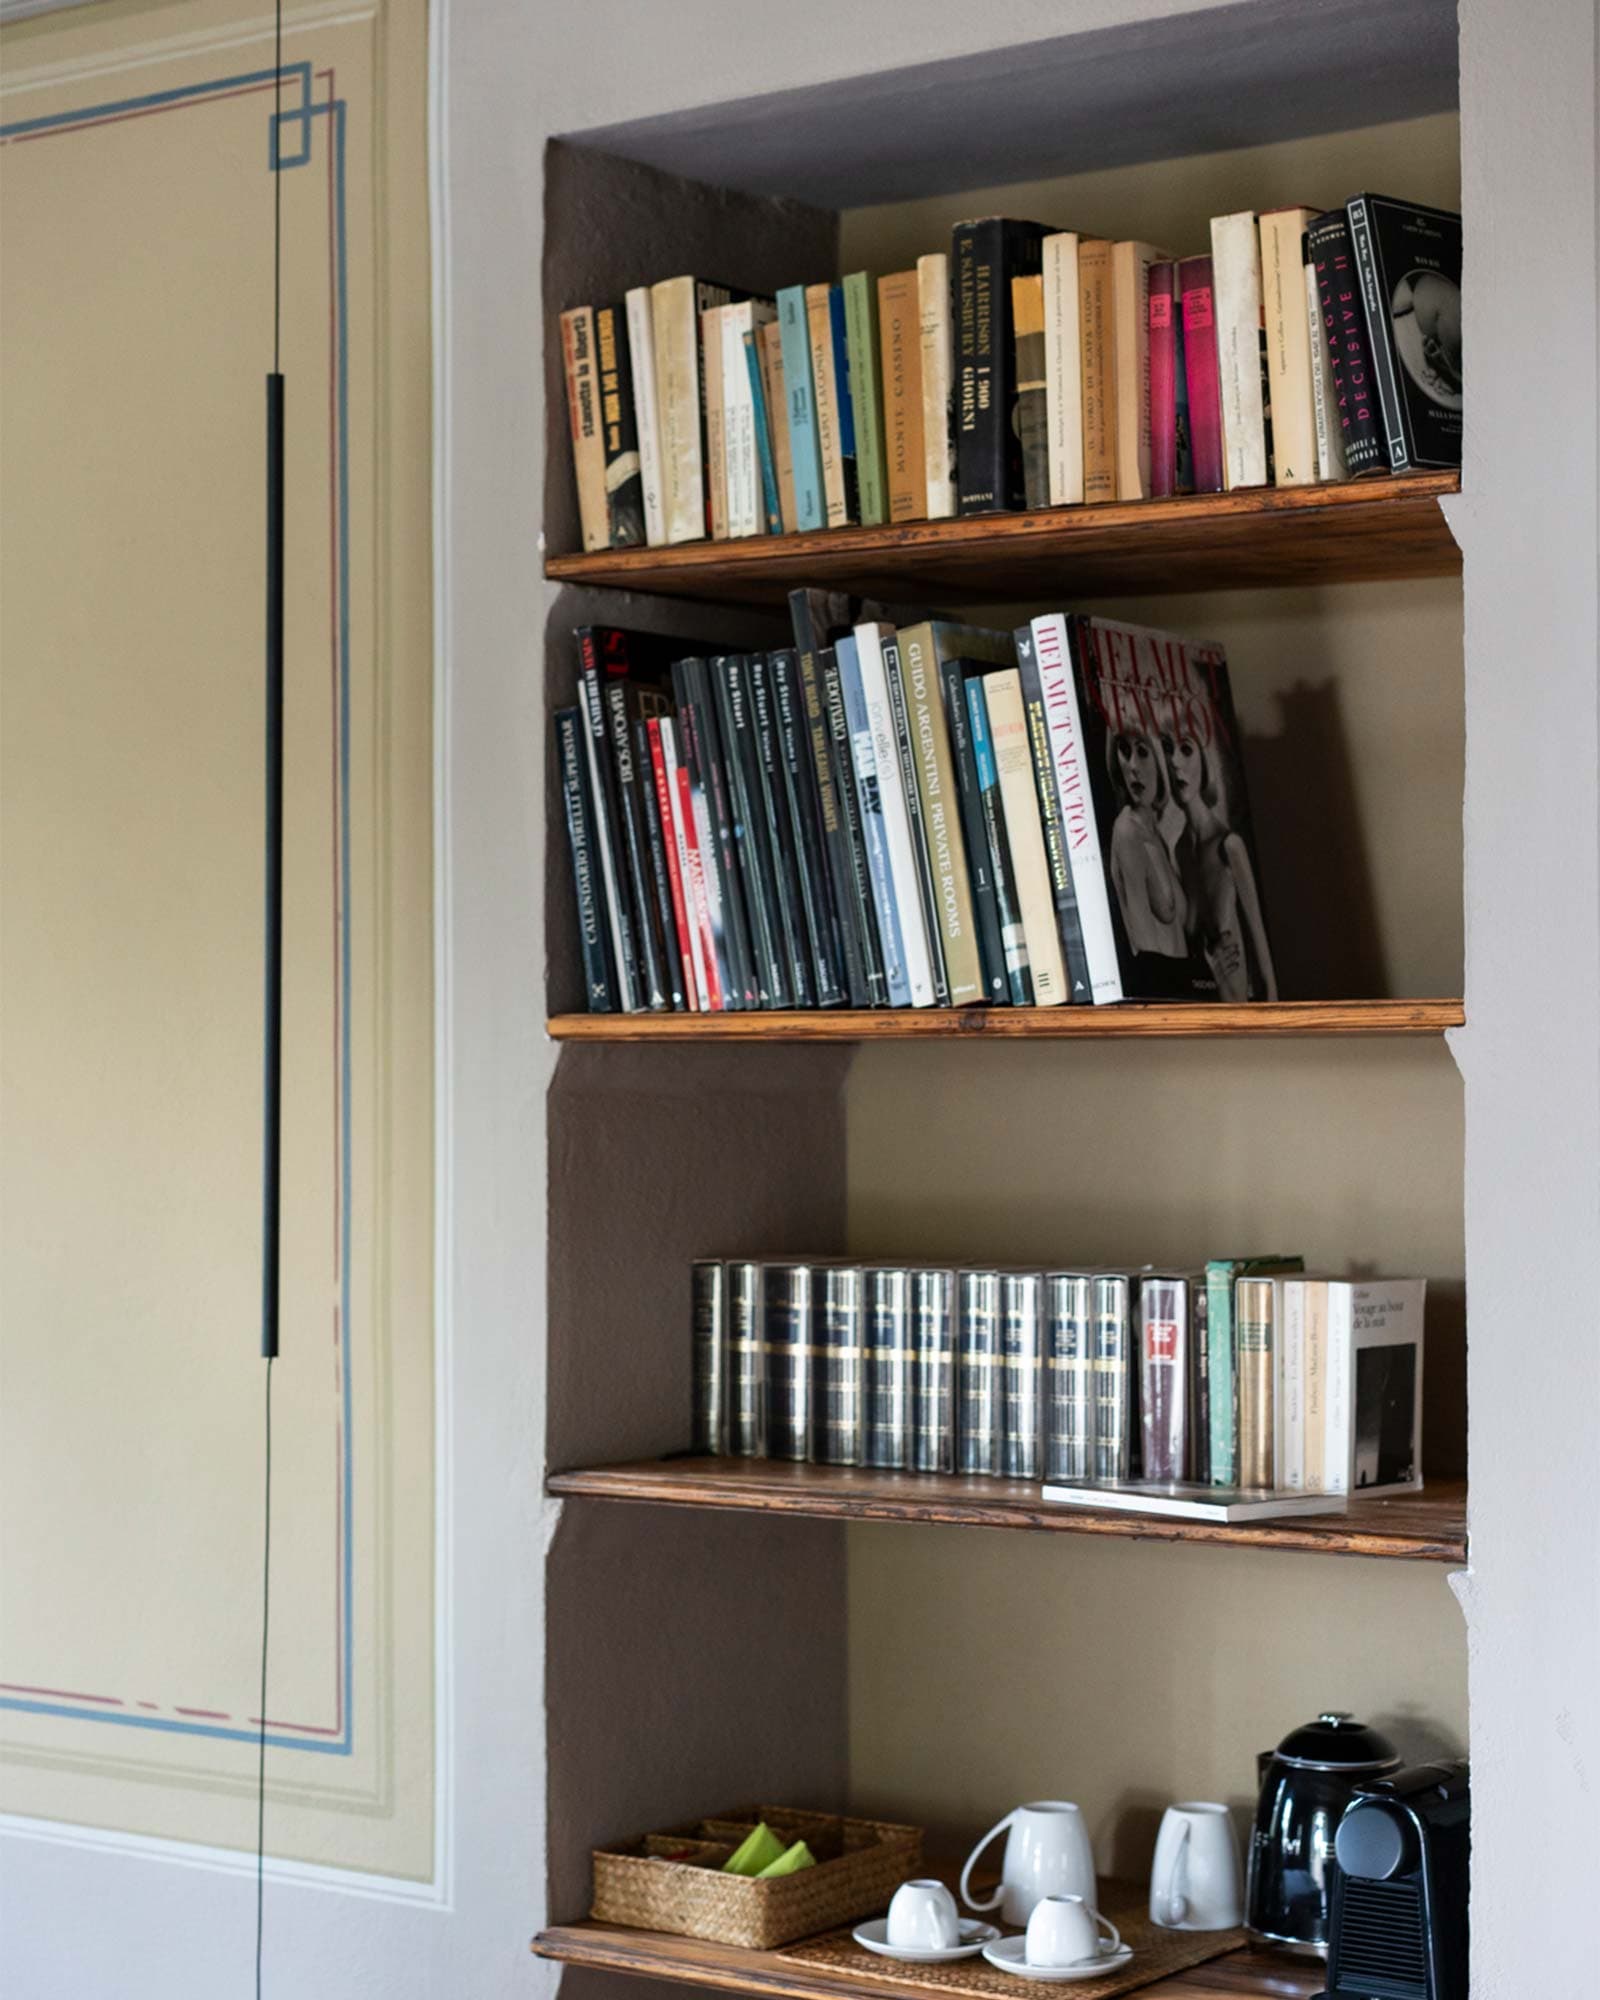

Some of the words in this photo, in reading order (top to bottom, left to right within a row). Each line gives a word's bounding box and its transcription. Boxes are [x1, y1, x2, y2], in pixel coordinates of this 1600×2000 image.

[1334, 255, 1348, 270] II
[960, 258, 973, 356] SALISBURY
[976, 264, 991, 354] HARRISON
[892, 317, 905, 397] CASSINO
[1317, 262, 1350, 427] BATTAGLIE
[1338, 290, 1370, 420] DECISIVE
[961, 366, 974, 431] GIORNI
[977, 378, 990, 409] 900
[895, 408, 905, 472] MONTE
[725, 665, 741, 690] Roy
[750, 663, 764, 686] Roy
[774, 660, 788, 683] Roy
[800, 651, 816, 682] TONY
[906, 642, 927, 700] GUIDO
[1077, 623, 1222, 700] HELMUT
[729, 689, 747, 728] Stuart
[755, 687, 770, 726] Stuart
[778, 683, 794, 723] Stuart
[804, 683, 821, 719] WARD
[561, 719, 580, 792] SUPERSTAR
[761, 729, 773, 762] Volume
[784, 726, 796, 759] Volume
[915, 702, 941, 796] ARGENTINI
[1035, 624, 1072, 737] HELMUT
[1055, 741, 1090, 850] NEWTON
[569, 795, 586, 847] PIRELLI
[1038, 769, 1059, 826] HELMUT
[929, 801, 952, 872] PRIVATE
[1048, 828, 1069, 889] NEWTON
[575, 849, 598, 944] CALENDARIO
[939, 874, 961, 938] ROOMS
